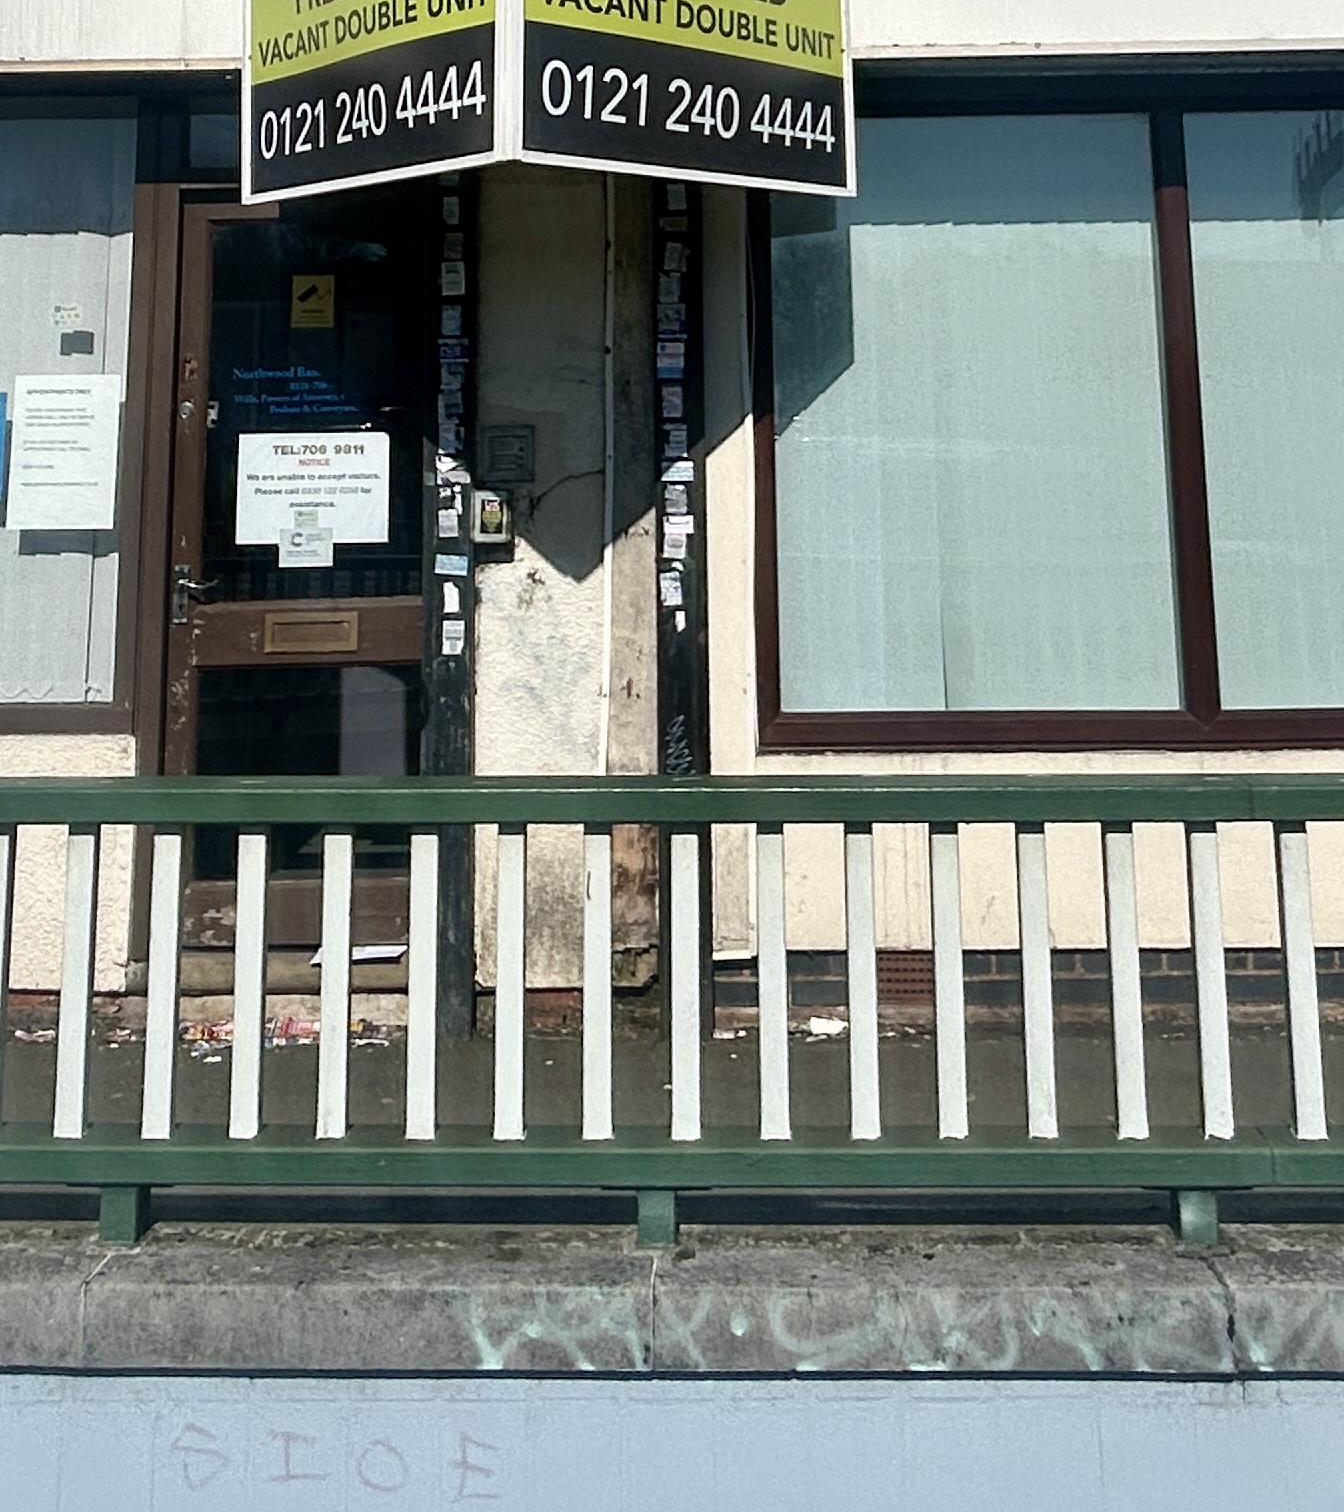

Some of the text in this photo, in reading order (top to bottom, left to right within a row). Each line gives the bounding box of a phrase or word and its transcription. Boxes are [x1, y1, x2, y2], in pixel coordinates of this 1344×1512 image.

[259, 20, 329, 67] VACANT
[676, 0, 778, 47] DOUBLE
[786, 23, 835, 59] UNIT
[260, 60, 487, 159] 0121 240 4444
[541, 59, 835, 153] 0121 240 4444
